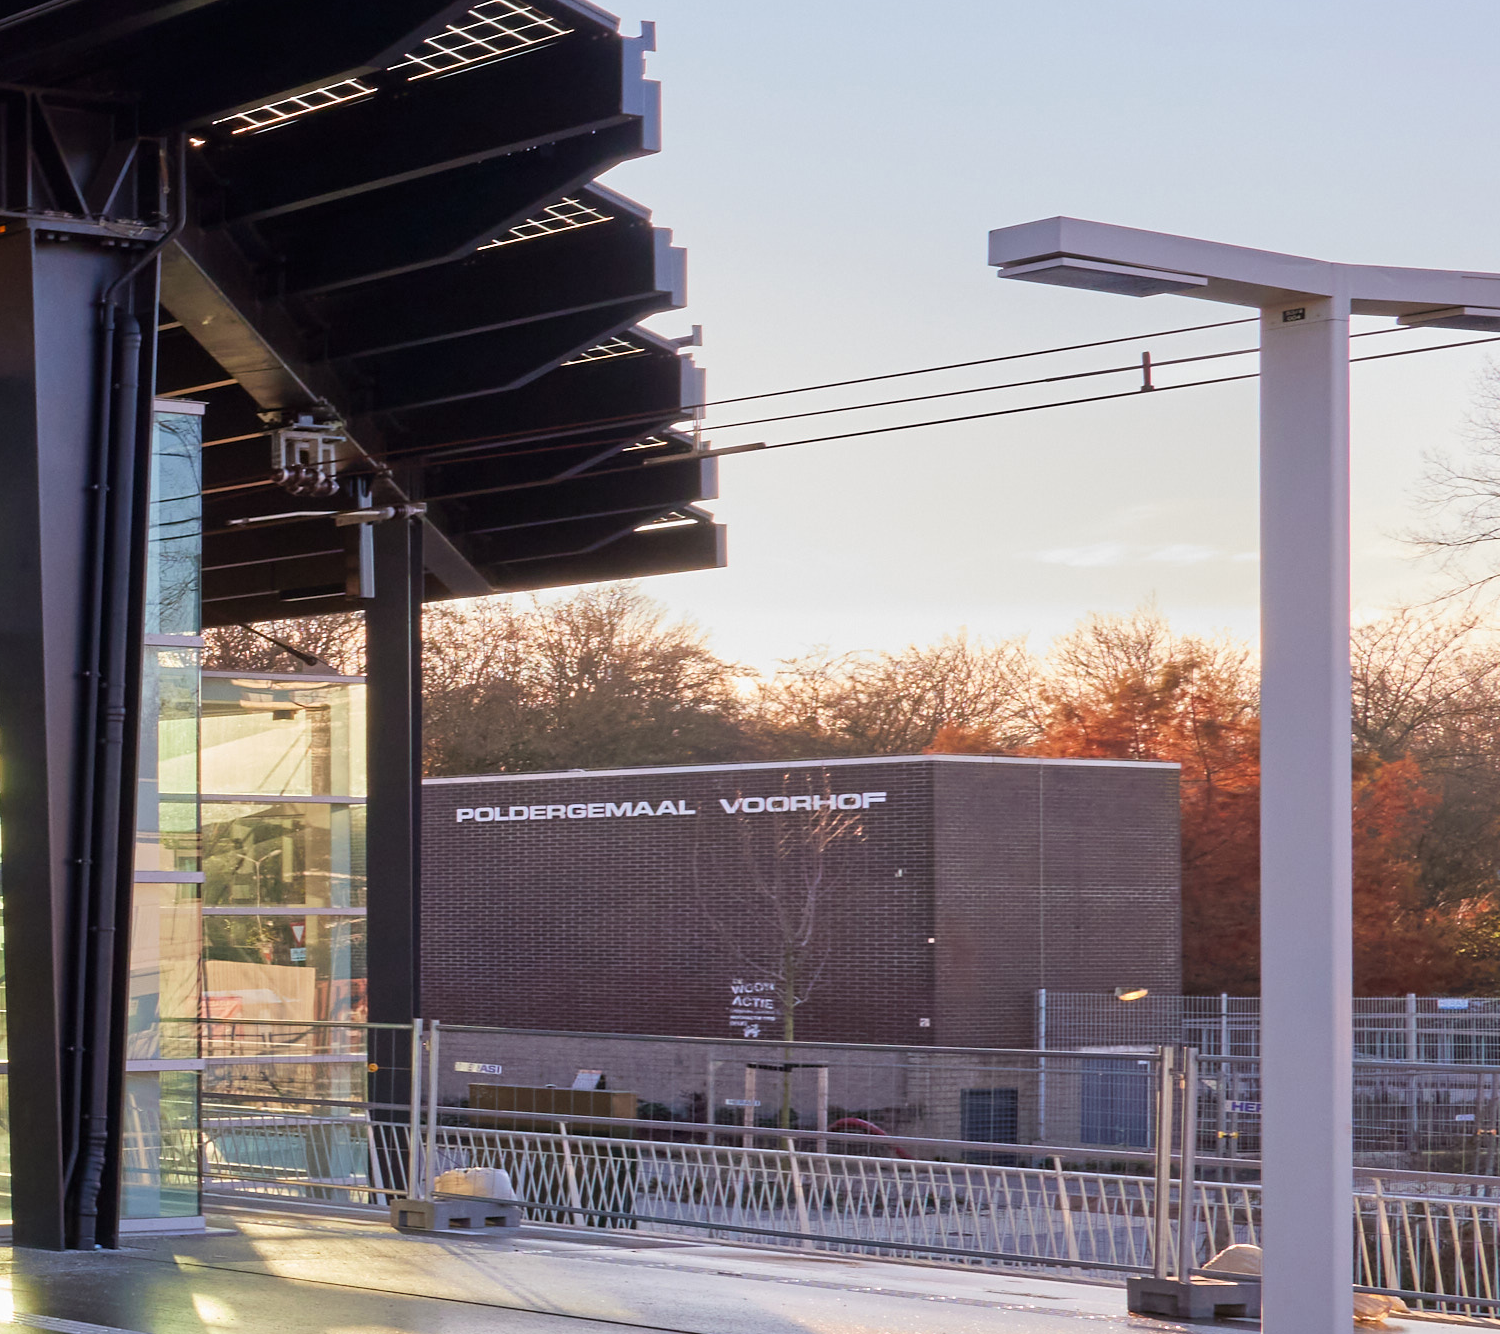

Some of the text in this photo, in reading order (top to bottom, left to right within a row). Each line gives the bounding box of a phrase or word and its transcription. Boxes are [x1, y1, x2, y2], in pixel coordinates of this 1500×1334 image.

[456, 791, 887, 823] POLDERGEMAAL VOORHOF
[732, 995, 774, 1009] ACTIE
